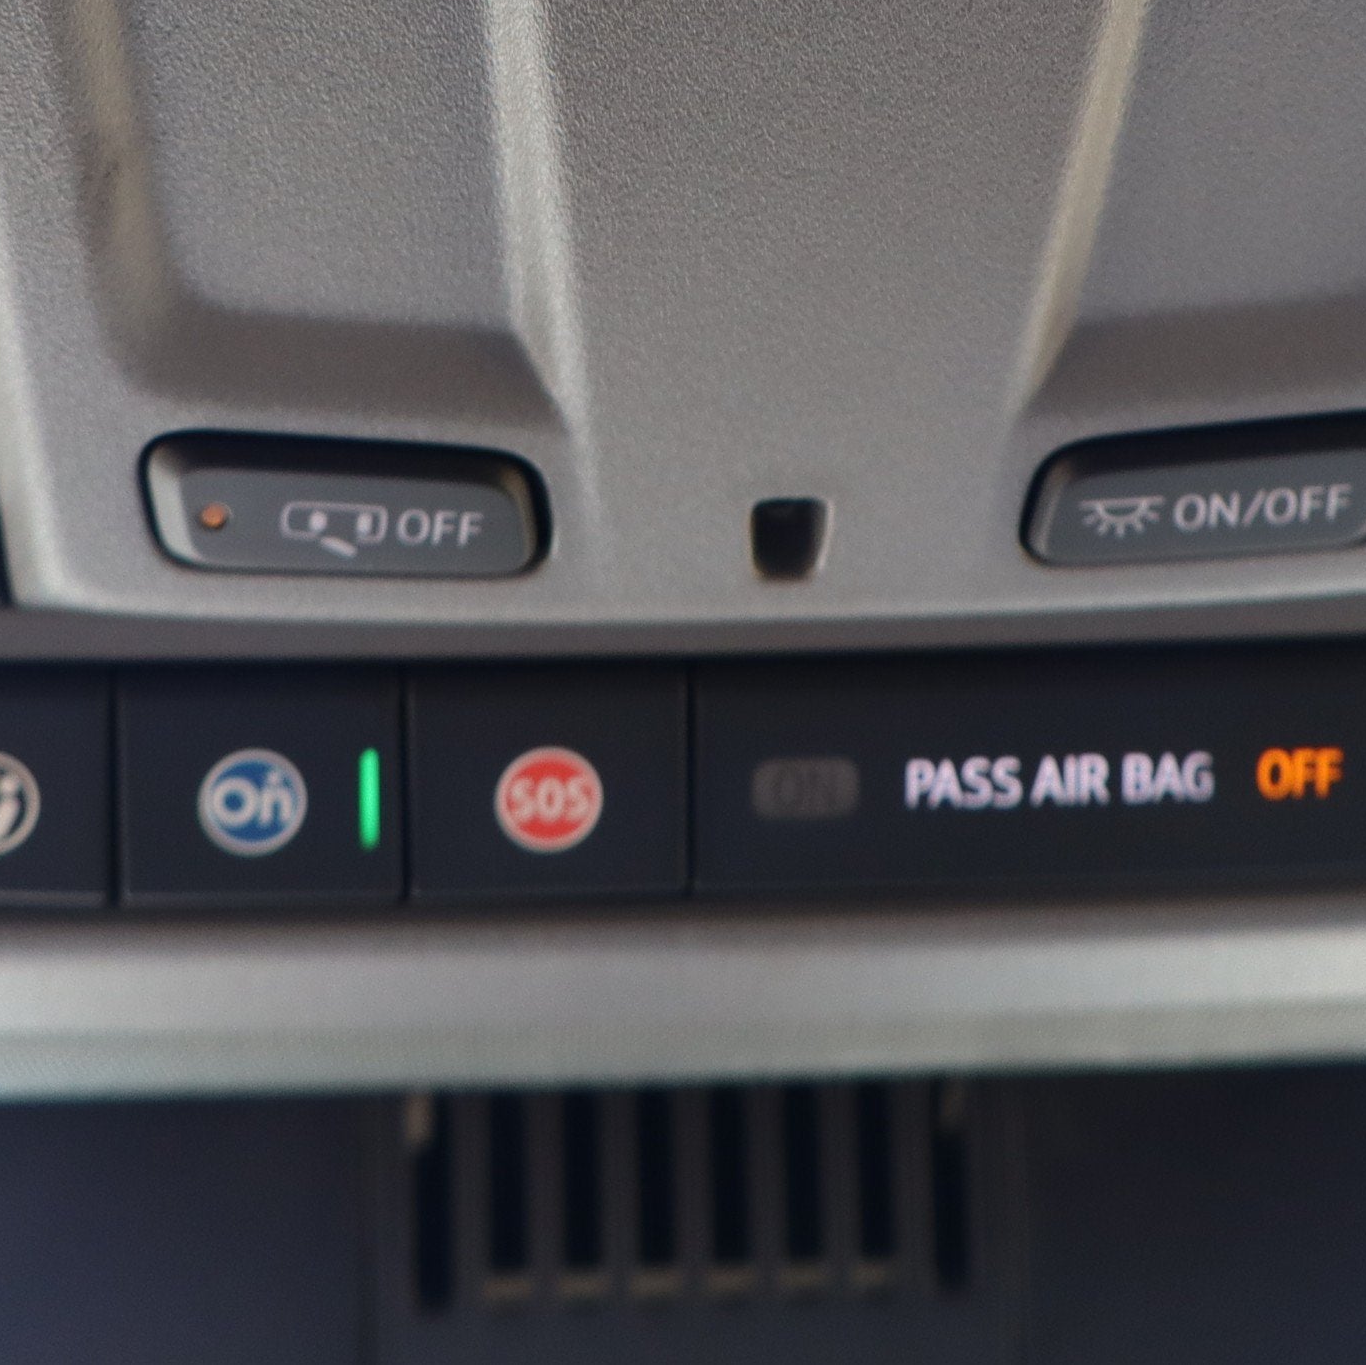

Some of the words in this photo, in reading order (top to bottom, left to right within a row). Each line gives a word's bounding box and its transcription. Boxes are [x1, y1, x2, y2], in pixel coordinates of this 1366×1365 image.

[397, 509, 484, 547] OFF
[1173, 483, 1352, 531] ON/OFF
[510, 776, 591, 824] SOS
[905, 758, 1023, 810] PASS
[1032, 754, 1110, 805] AIR
[1122, 750, 1215, 803] BAG
[1257, 746, 1343, 800] OFF
